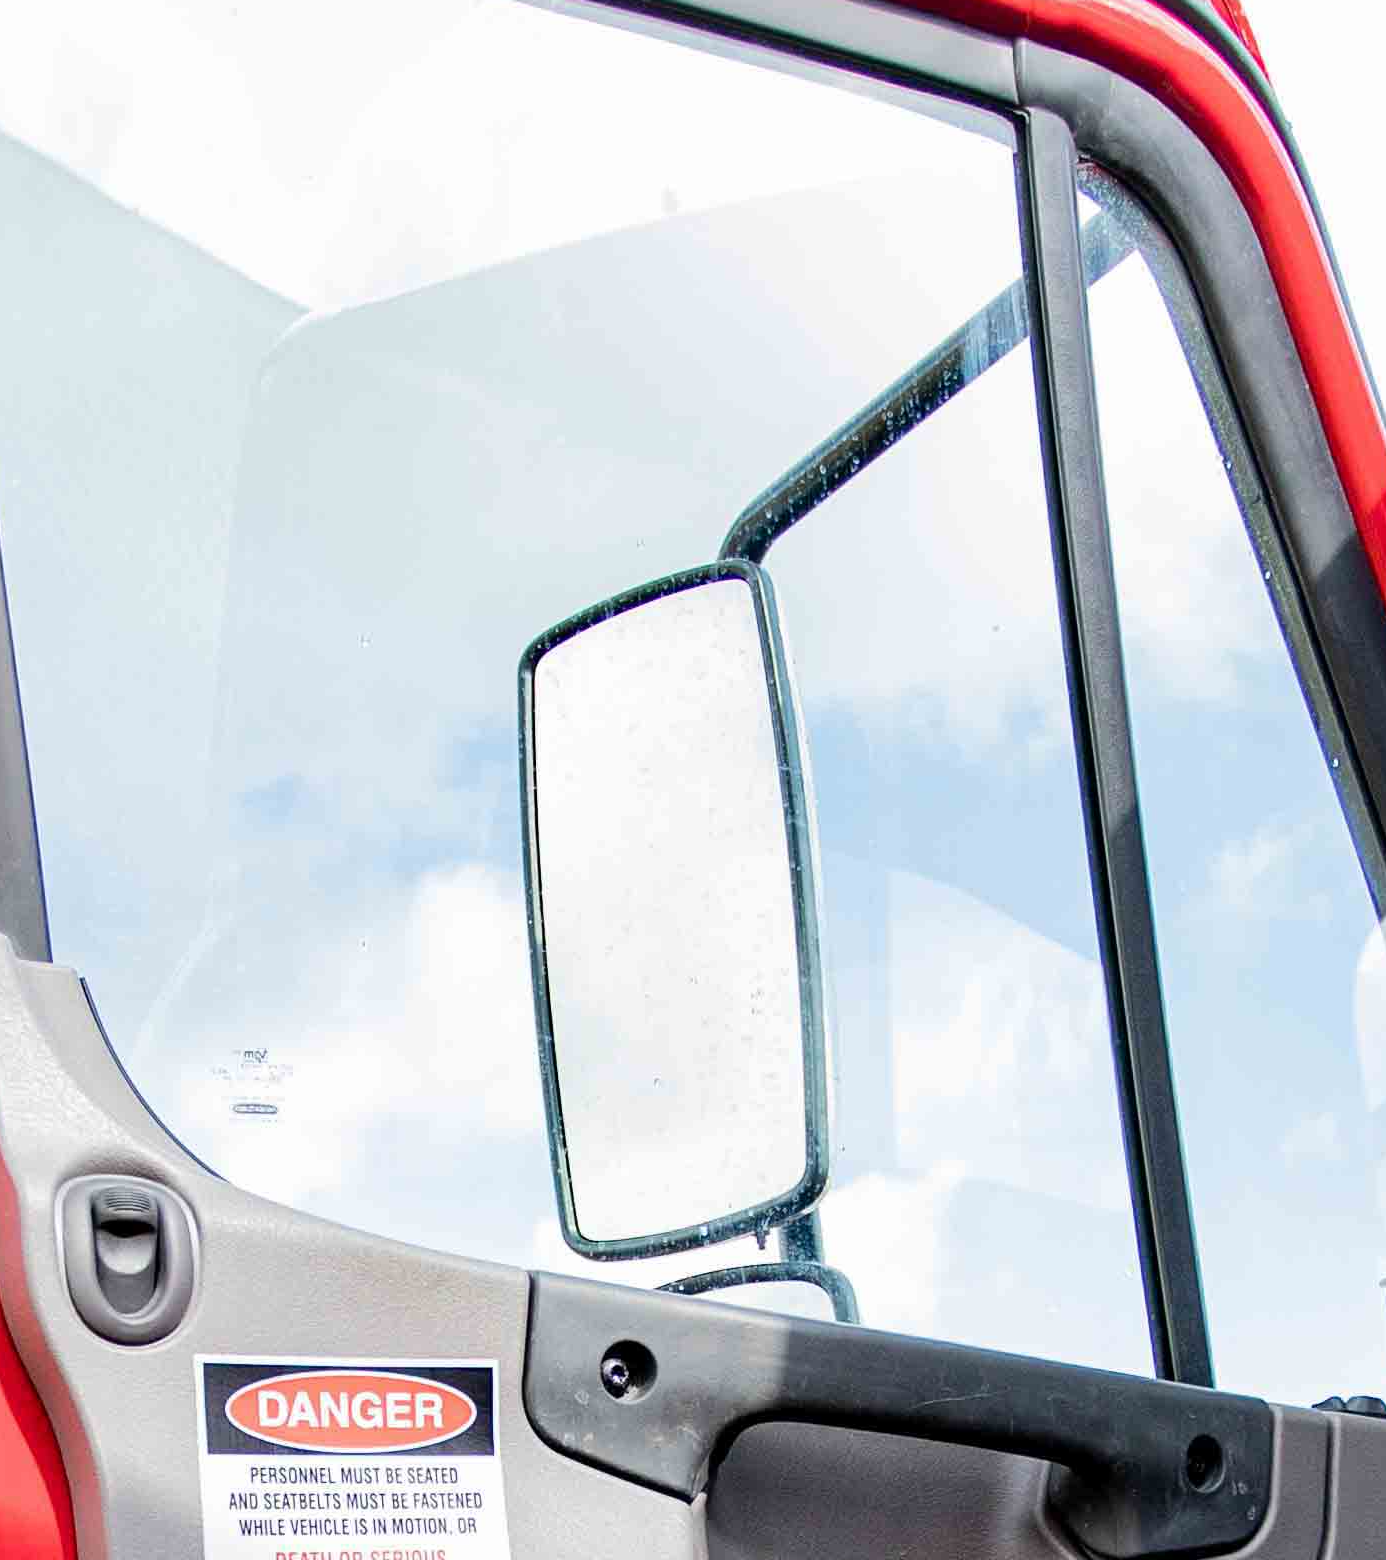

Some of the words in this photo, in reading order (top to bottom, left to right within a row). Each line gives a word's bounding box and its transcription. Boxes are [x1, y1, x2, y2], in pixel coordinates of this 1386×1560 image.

[258, 1390, 444, 1429] DANGER
[250, 1467, 335, 1484] PERSONNEL
[341, 1467, 380, 1484] MUST
[386, 1468, 403, 1484] BE
[408, 1468, 458, 1484] SEATED
[229, 1493, 258, 1510] AND
[264, 1493, 341, 1510] SEATBELTS
[347, 1493, 386, 1509] MUST
[392, 1493, 409, 1509] BE
[413, 1493, 482, 1509] FASTENED
[239, 1519, 286, 1536] WHILE
[291, 1519, 349, 1536] VEHICLE
[355, 1519, 368, 1535] IS
[373, 1518, 387, 1535] IN
[457, 1517, 477, 1534] OR
